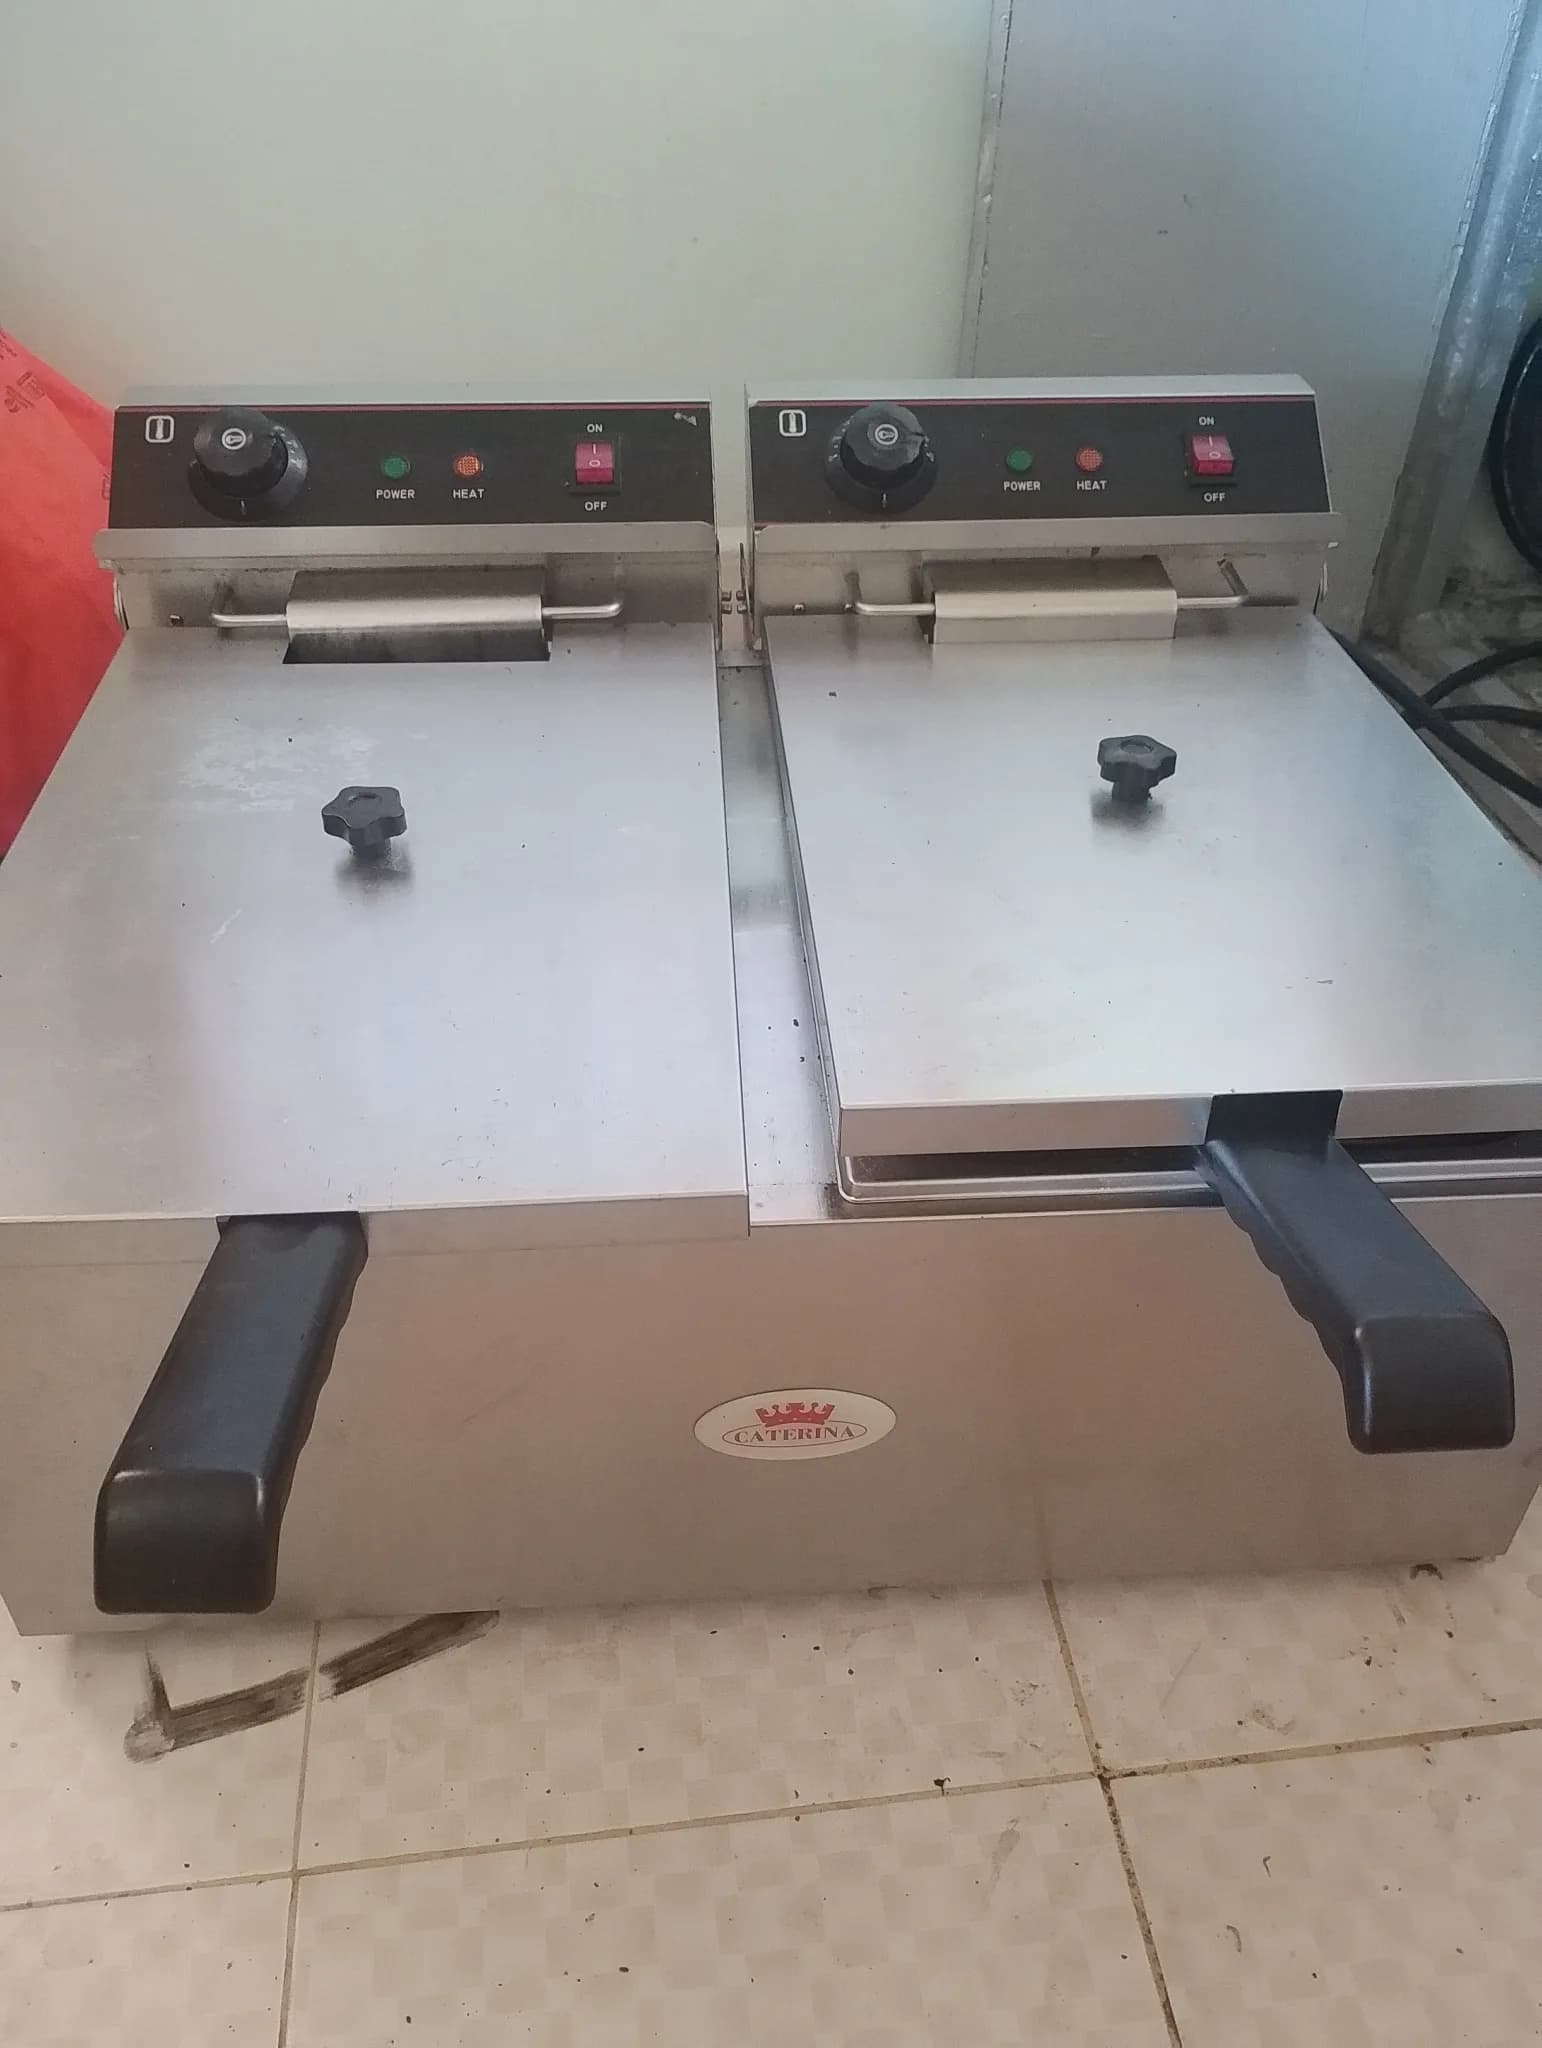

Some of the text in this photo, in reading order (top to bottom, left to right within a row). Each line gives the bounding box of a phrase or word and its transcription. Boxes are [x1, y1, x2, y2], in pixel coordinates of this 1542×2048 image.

[1199, 416, 1214, 426] ON
[587, 423, 603, 433] ON
[1003, 481, 1041, 492] POWER
[1076, 480, 1107, 491] HEAT
[376, 489, 415, 500] POWER
[453, 488, 485, 499] HEAT
[1204, 493, 1226, 503] OFF
[584, 501, 607, 511] OFF
[733, 1426, 854, 1443] CATERINA
